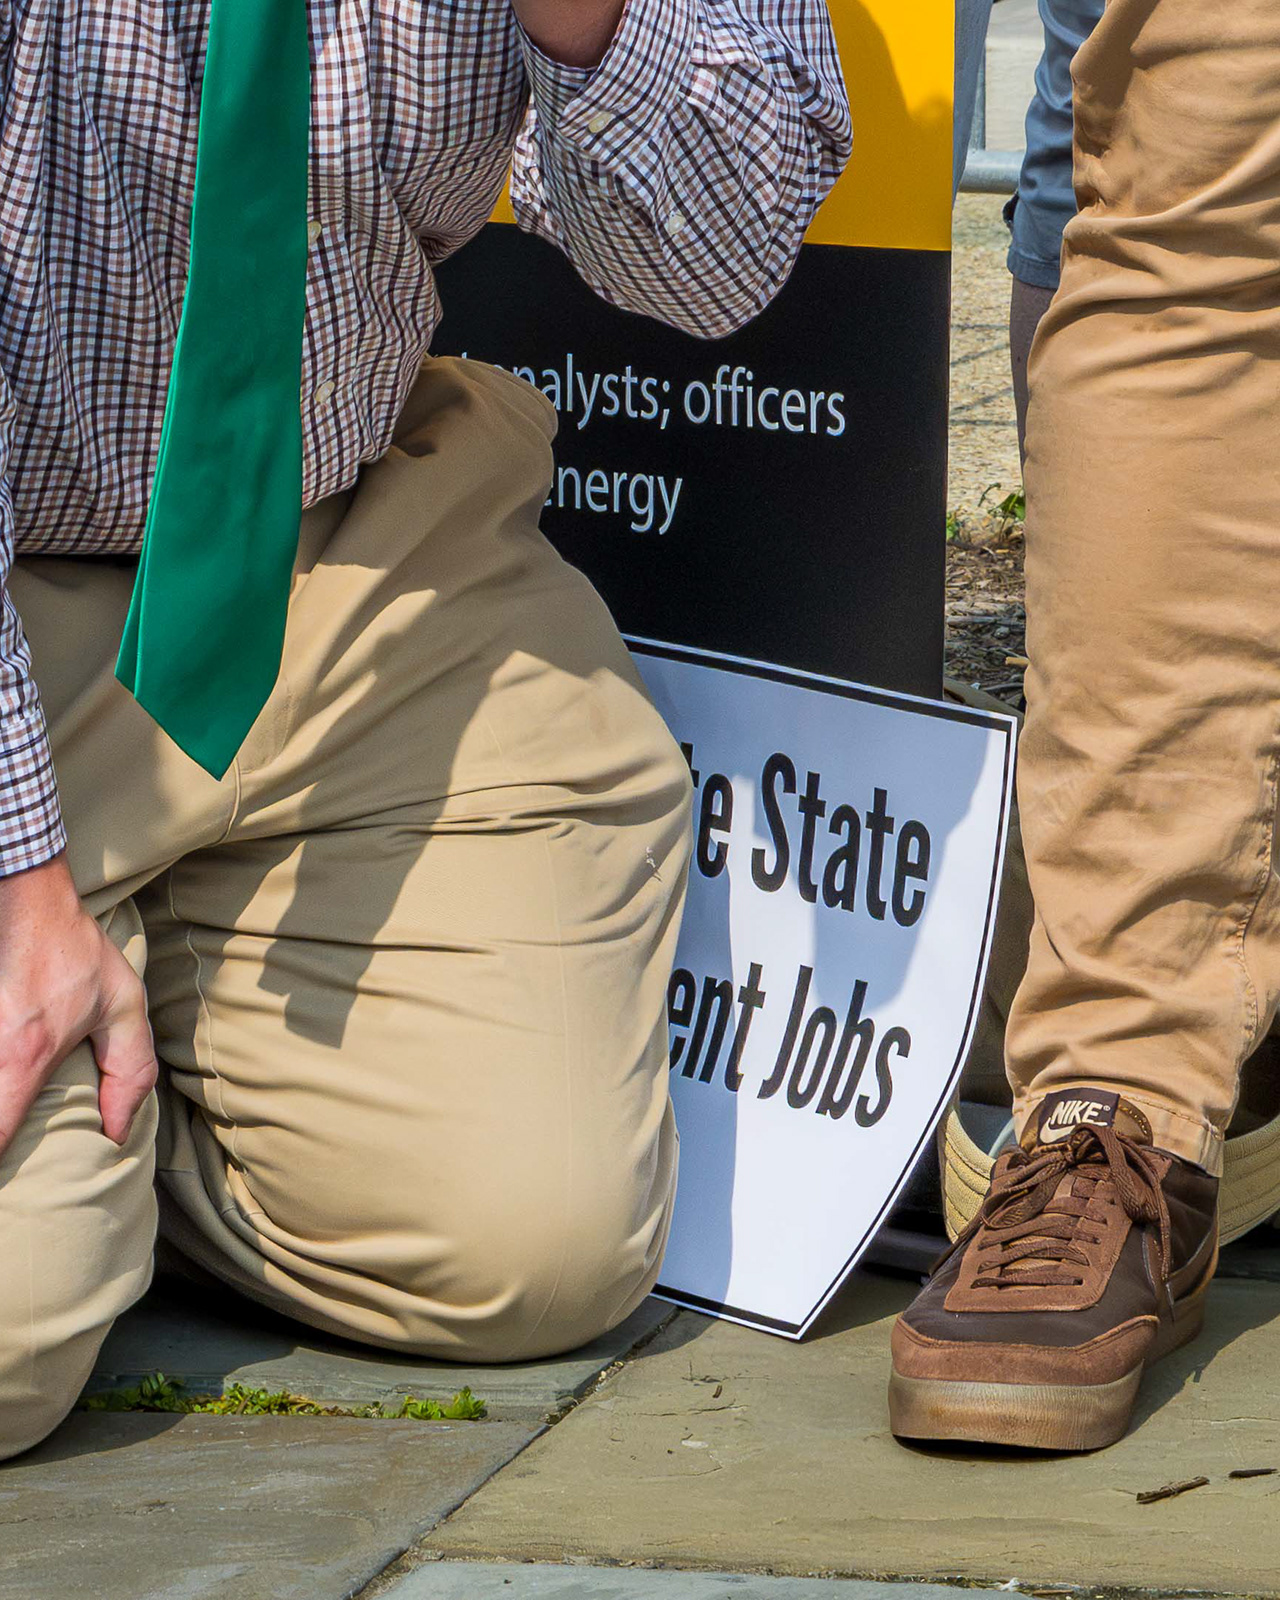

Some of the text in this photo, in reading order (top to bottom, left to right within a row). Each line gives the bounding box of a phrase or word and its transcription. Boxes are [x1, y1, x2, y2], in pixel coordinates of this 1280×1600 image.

[683, 364, 847, 437] officers
[545, 466, 683, 535] nergy
[751, 751, 932, 928] State
[758, 963, 912, 1128] Jobs
[1050, 1100, 1104, 1125] NIKE
